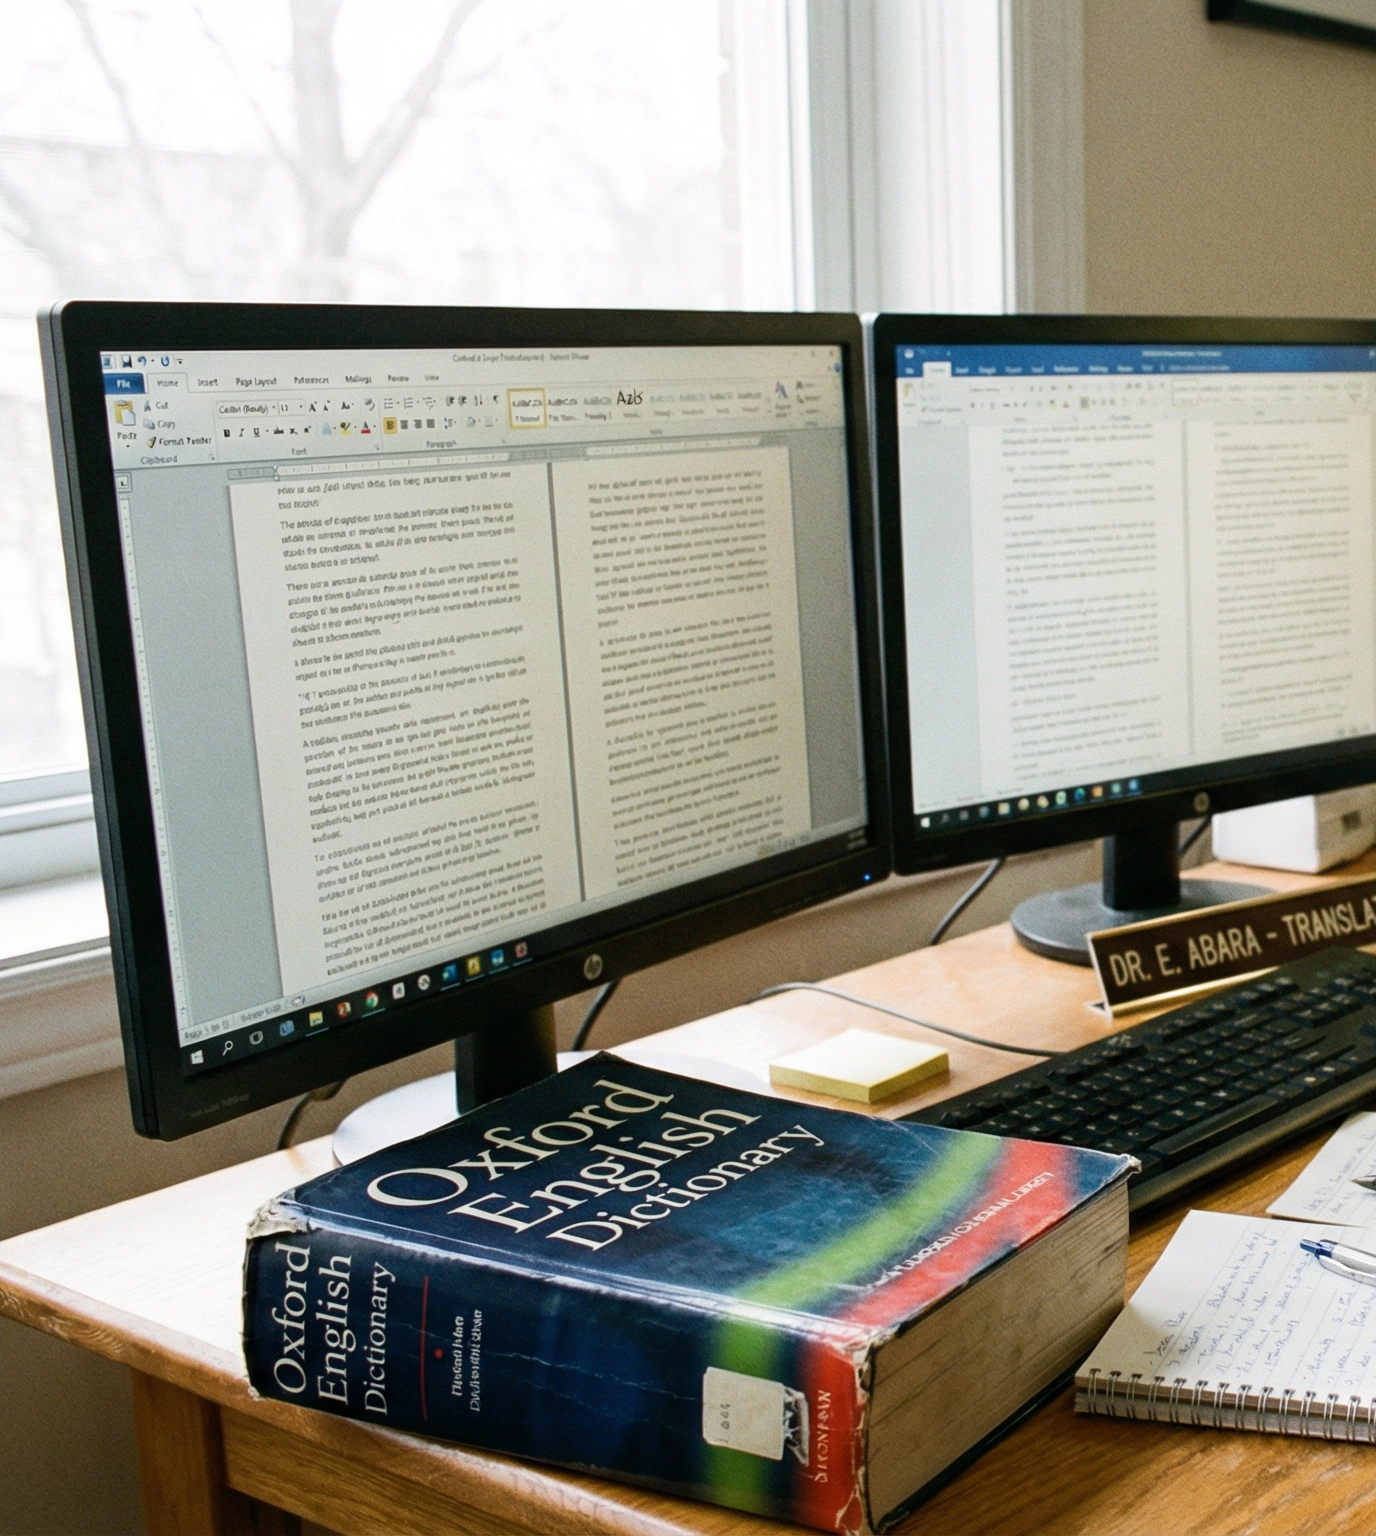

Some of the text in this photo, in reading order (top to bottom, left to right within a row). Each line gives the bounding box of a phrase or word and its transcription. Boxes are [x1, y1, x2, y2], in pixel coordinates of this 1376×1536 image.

[1109, 950, 1152, 987] DR.
[1156, 943, 1182, 977] E.
[1187, 925, 1264, 971] ABARA
[366, 1079, 675, 1208] Oxford
[447, 1104, 763, 1235] English
[545, 1124, 826, 1252] Dictionary
[271, 1241, 311, 1395] Oxford
[315, 1253, 356, 1407] English
[364, 1261, 397, 1416] Dictionary
